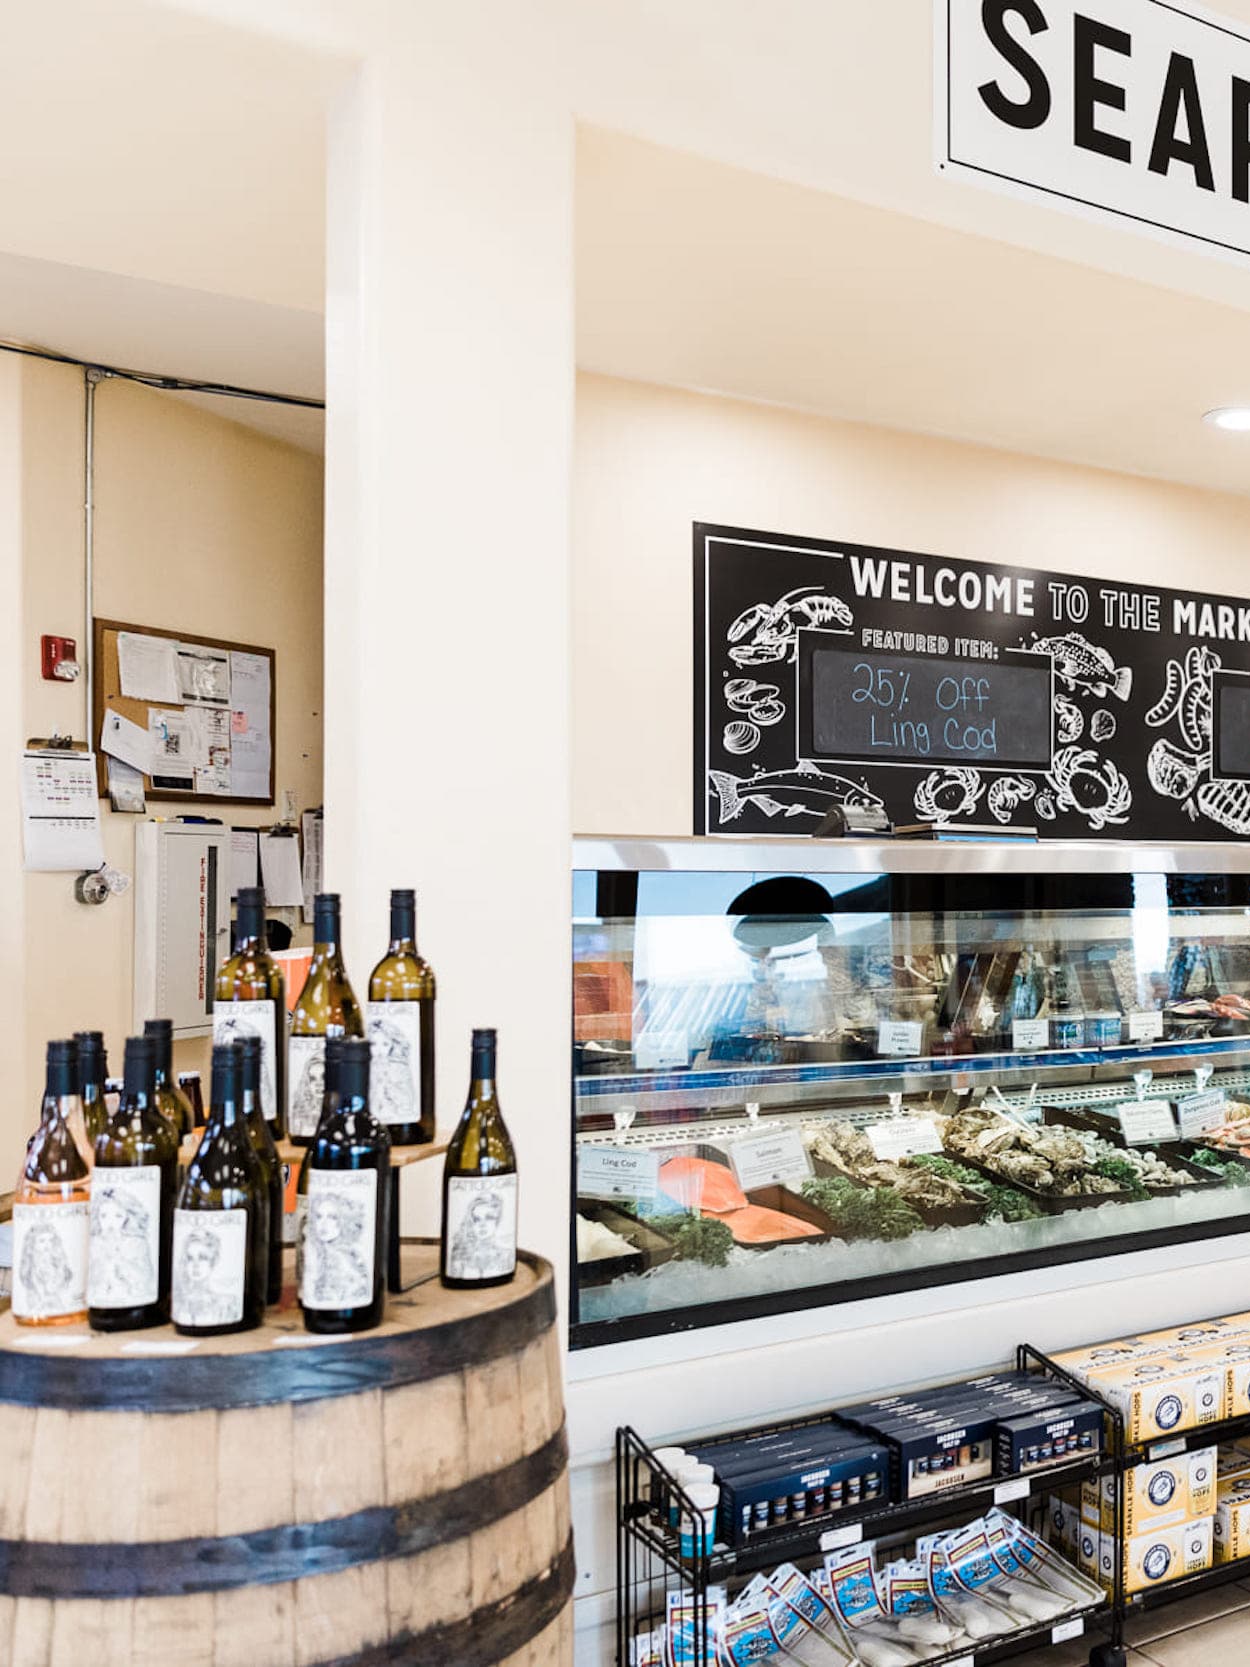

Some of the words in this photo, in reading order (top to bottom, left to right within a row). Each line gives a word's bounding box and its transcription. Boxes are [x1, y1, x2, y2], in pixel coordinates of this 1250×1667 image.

[850, 556, 1035, 617] WELCOME
[1048, 582, 1089, 623] TO
[1101, 589, 1161, 632] THE
[862, 628, 950, 655] FEATURED
[954, 638, 1000, 659] ITEM:
[852, 663, 911, 710] 25%
[870, 713, 930, 754] Ling
[943, 718, 997, 753] Cod
